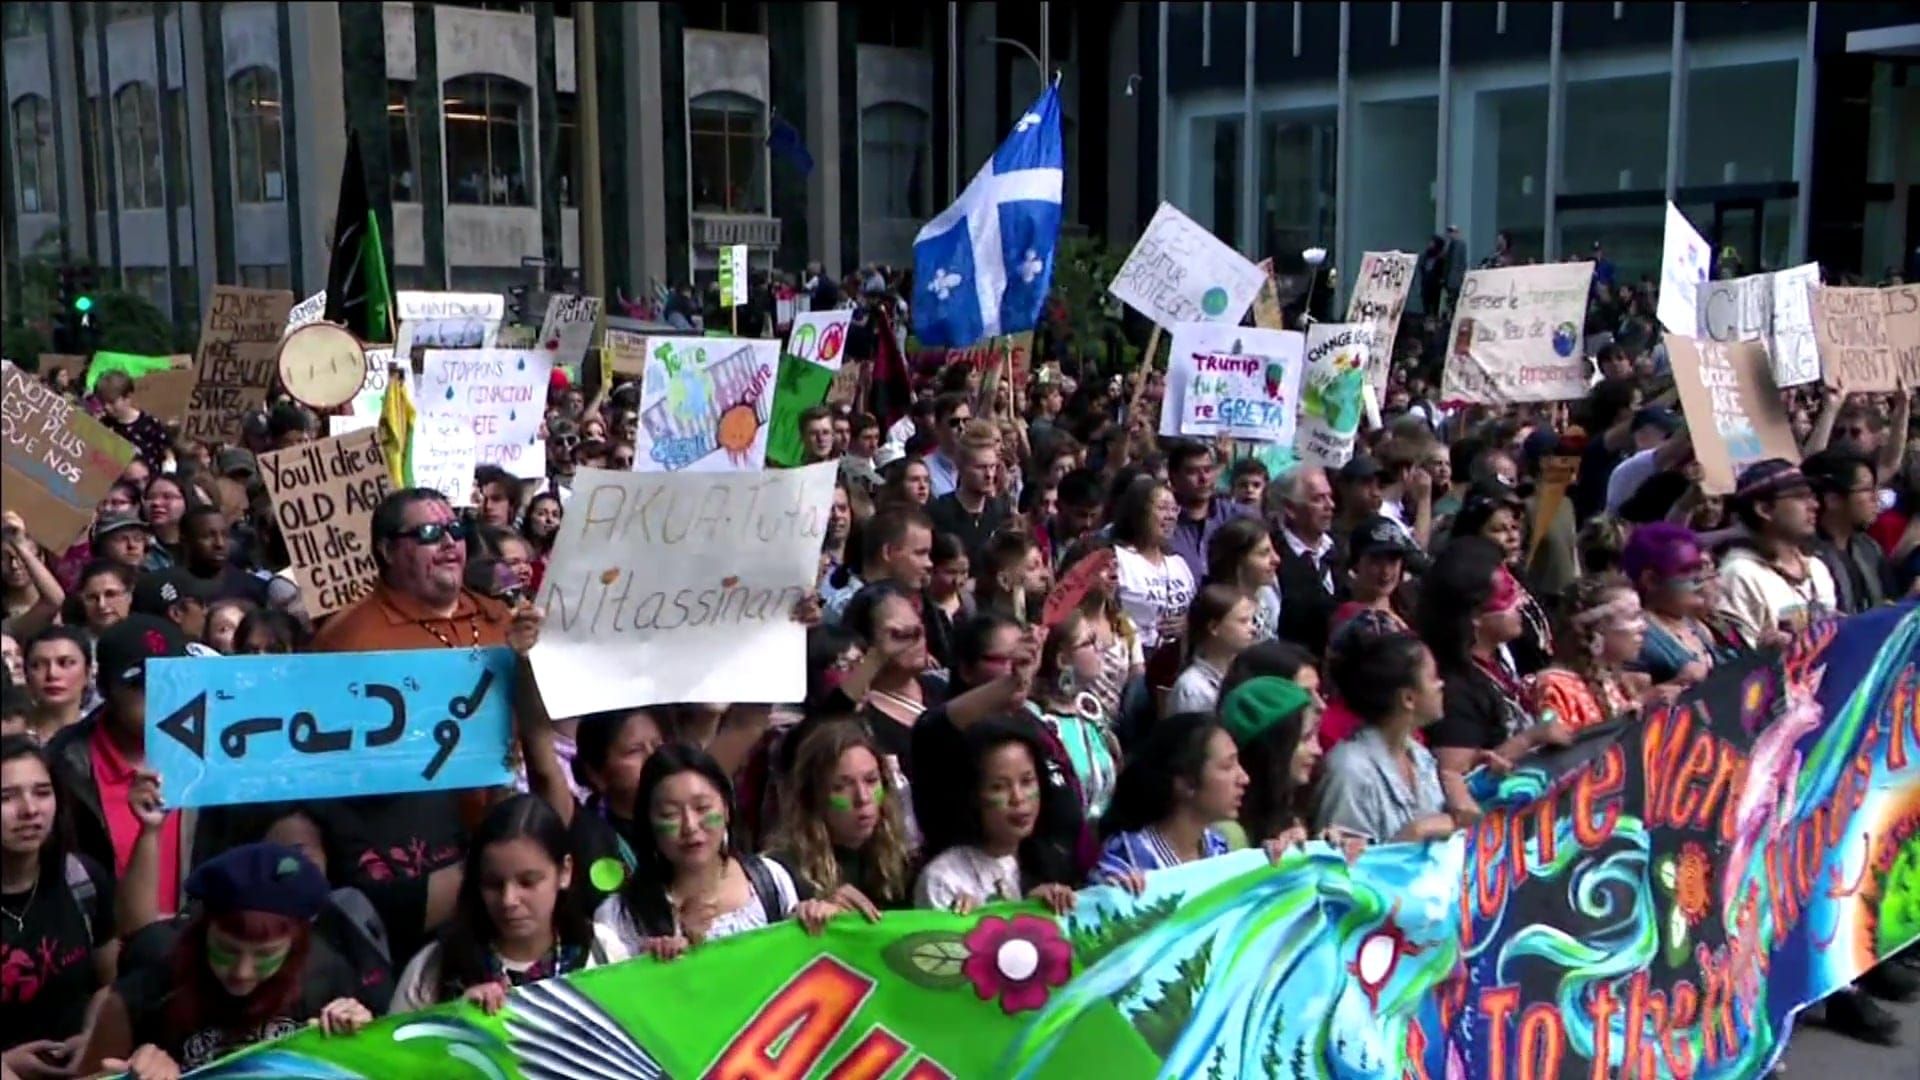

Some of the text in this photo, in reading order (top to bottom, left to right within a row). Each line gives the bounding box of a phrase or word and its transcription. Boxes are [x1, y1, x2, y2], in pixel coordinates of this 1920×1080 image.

[7, 372, 75, 424] NOTRE
[40, 412, 86, 458] PLUS
[42, 448, 83, 483] NOS
[261, 445, 327, 494] You'll
[331, 440, 365, 477] die
[279, 491, 336, 531] OLD
[324, 524, 362, 560] die
